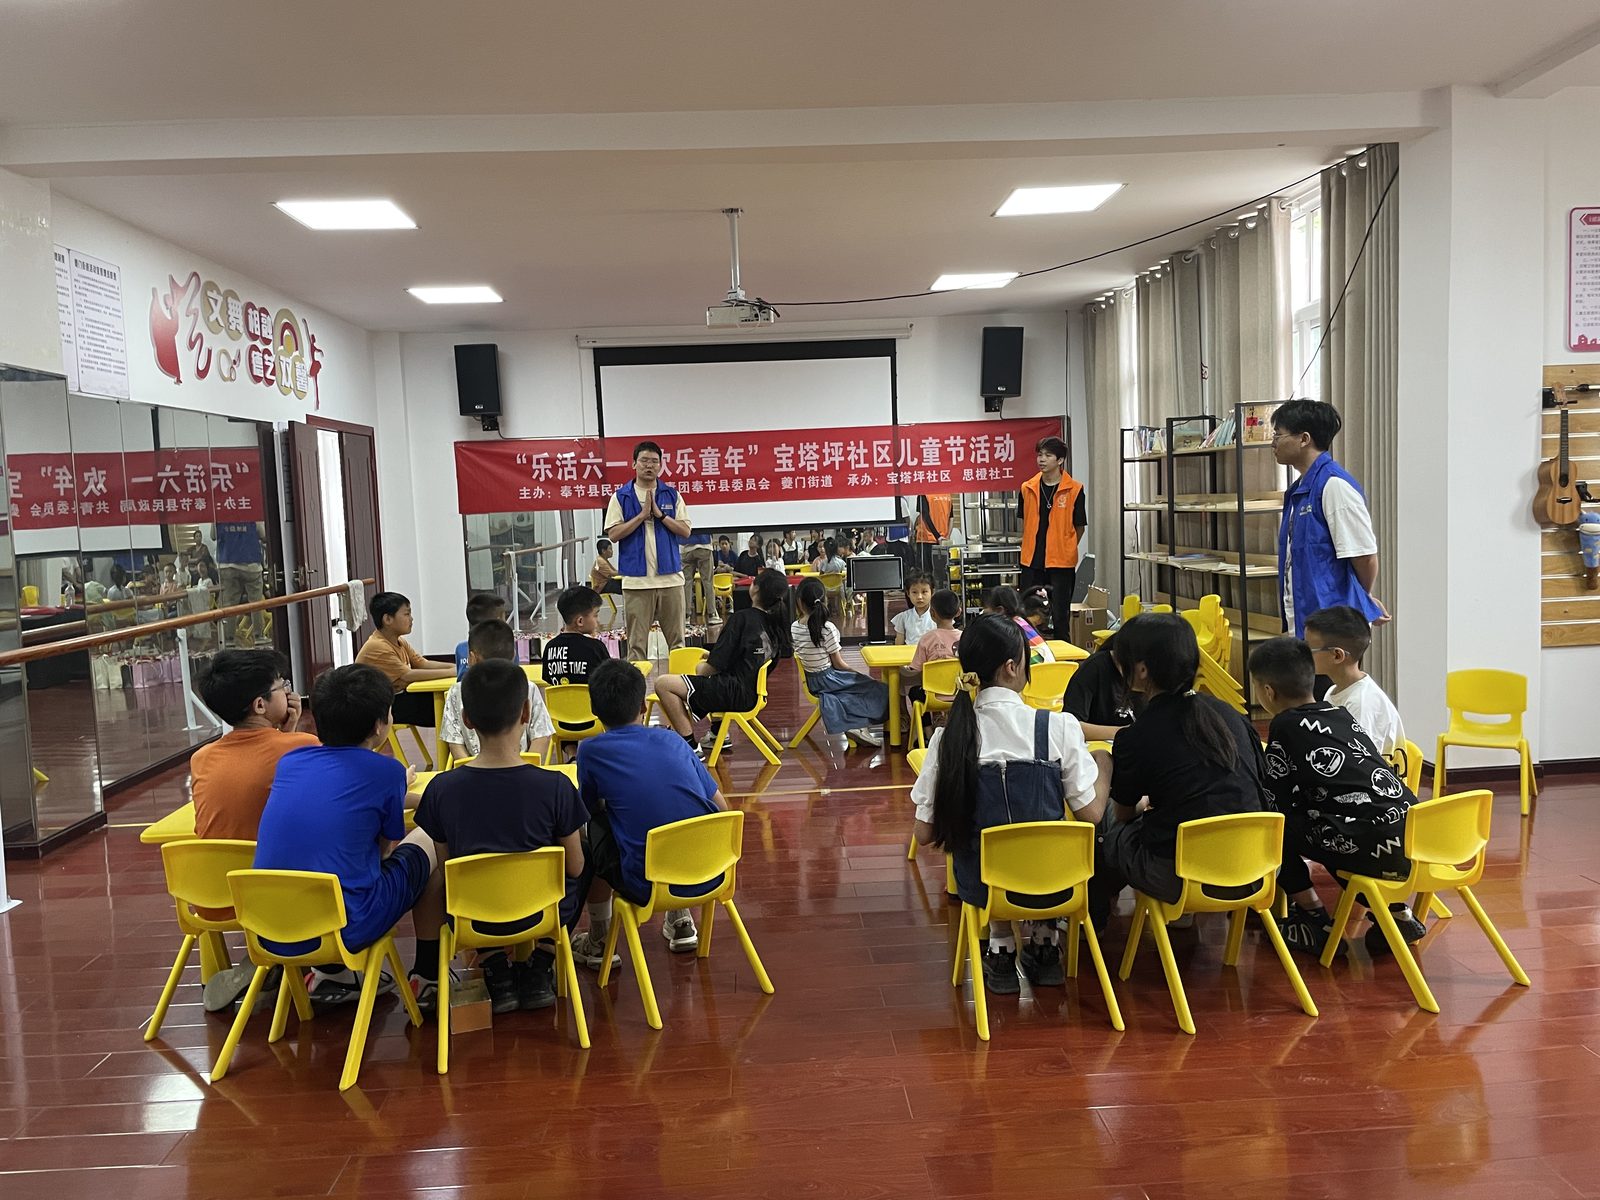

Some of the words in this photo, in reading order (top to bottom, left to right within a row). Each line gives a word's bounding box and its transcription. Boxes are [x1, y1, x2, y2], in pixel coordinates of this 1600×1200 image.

[516, 452, 628, 482] “乐活六一
[773, 433, 1016, 473] 宝塔坪社区儿童节活动
[962, 467, 1014, 481] 思橙社工
[548, 647, 568, 660] MAKE
[548, 662, 567, 675] SOME
[569, 662, 587, 675] TIME
